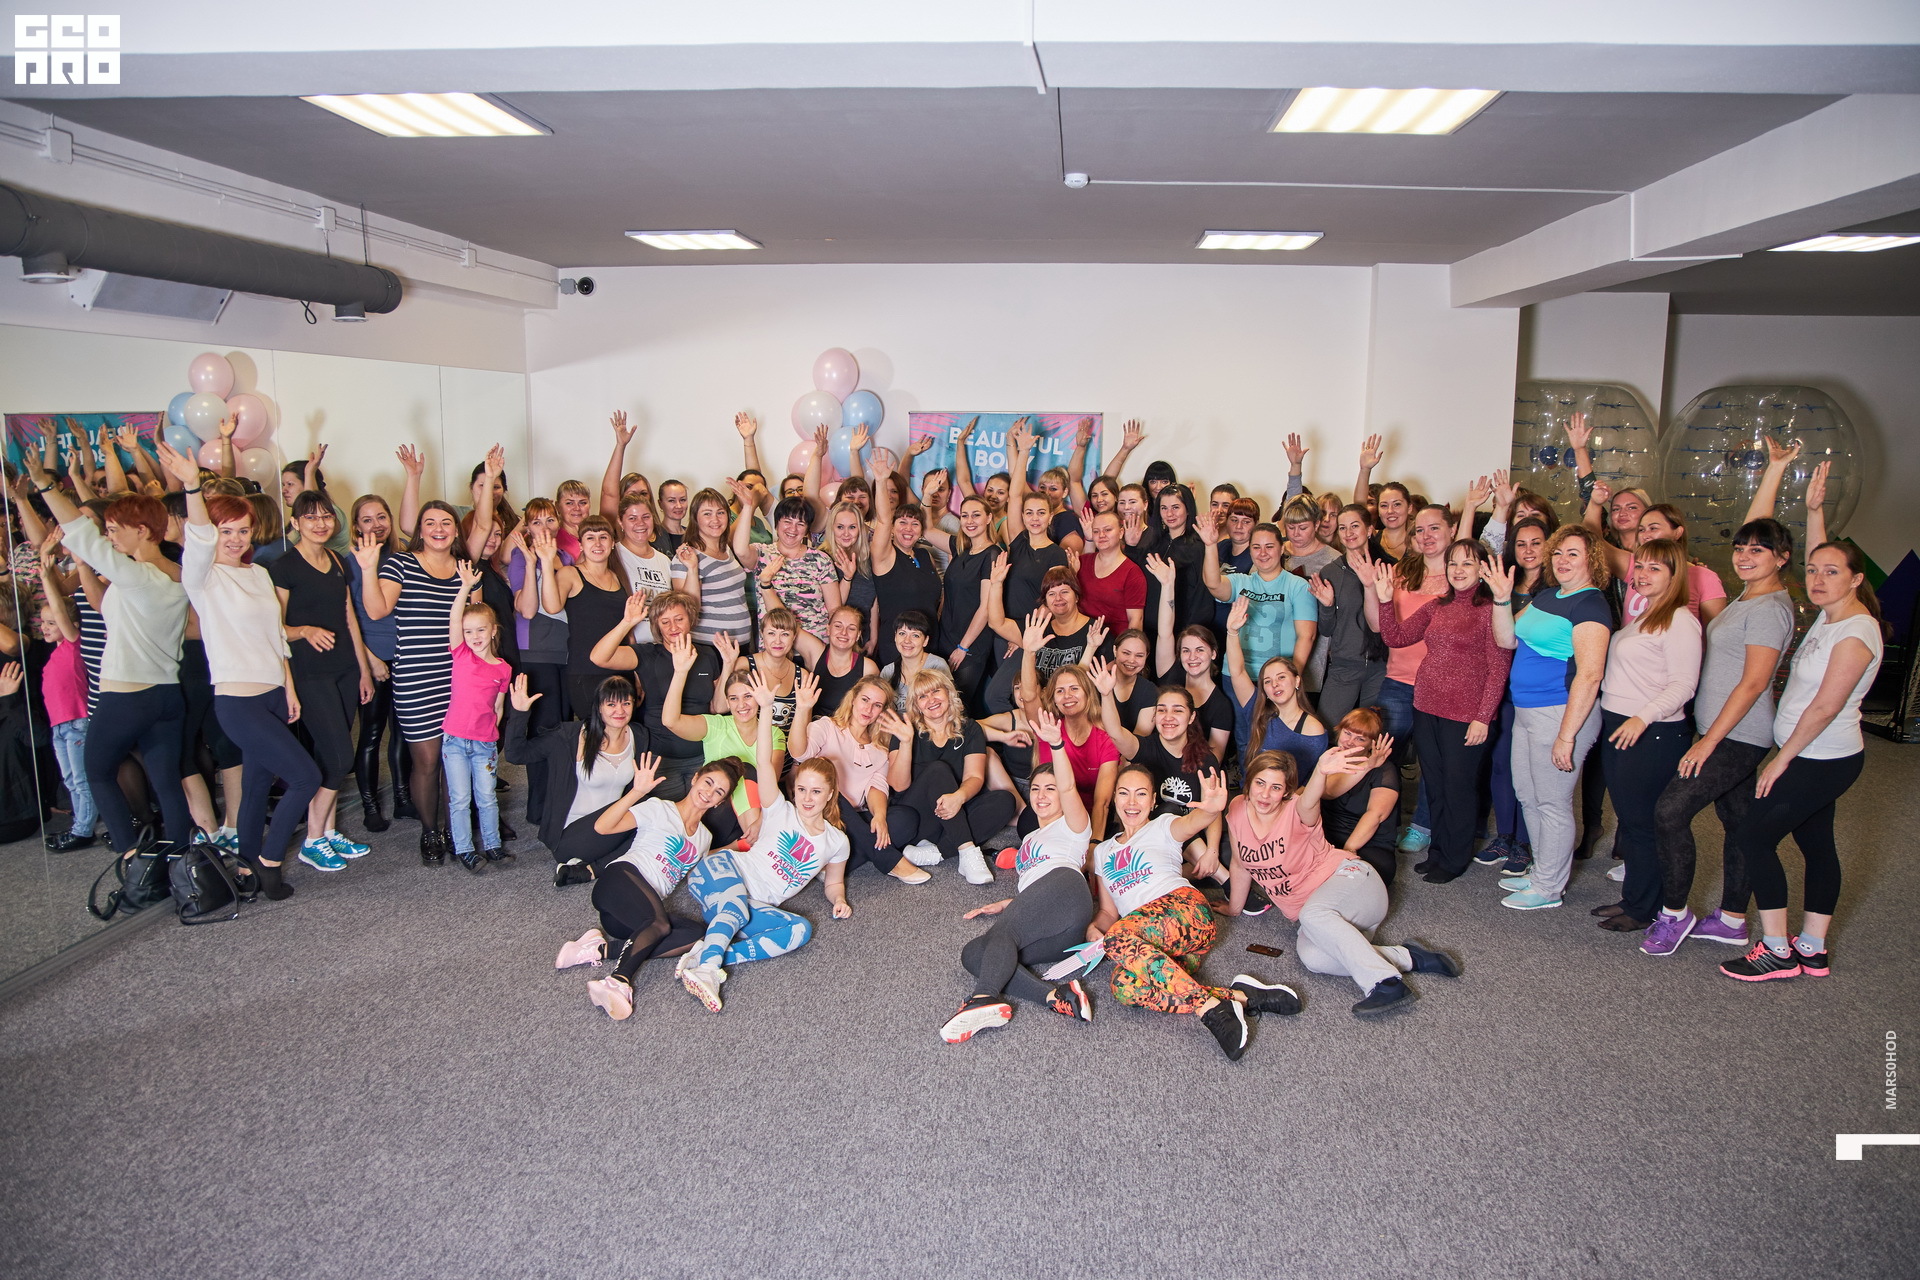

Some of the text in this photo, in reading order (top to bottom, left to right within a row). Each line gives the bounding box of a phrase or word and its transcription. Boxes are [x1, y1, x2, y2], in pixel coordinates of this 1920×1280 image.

[767, 850, 806, 886] BEAUTIFUL
[771, 862, 795, 885] BODY
[1109, 868, 1153, 893] BEAUTIFUL
